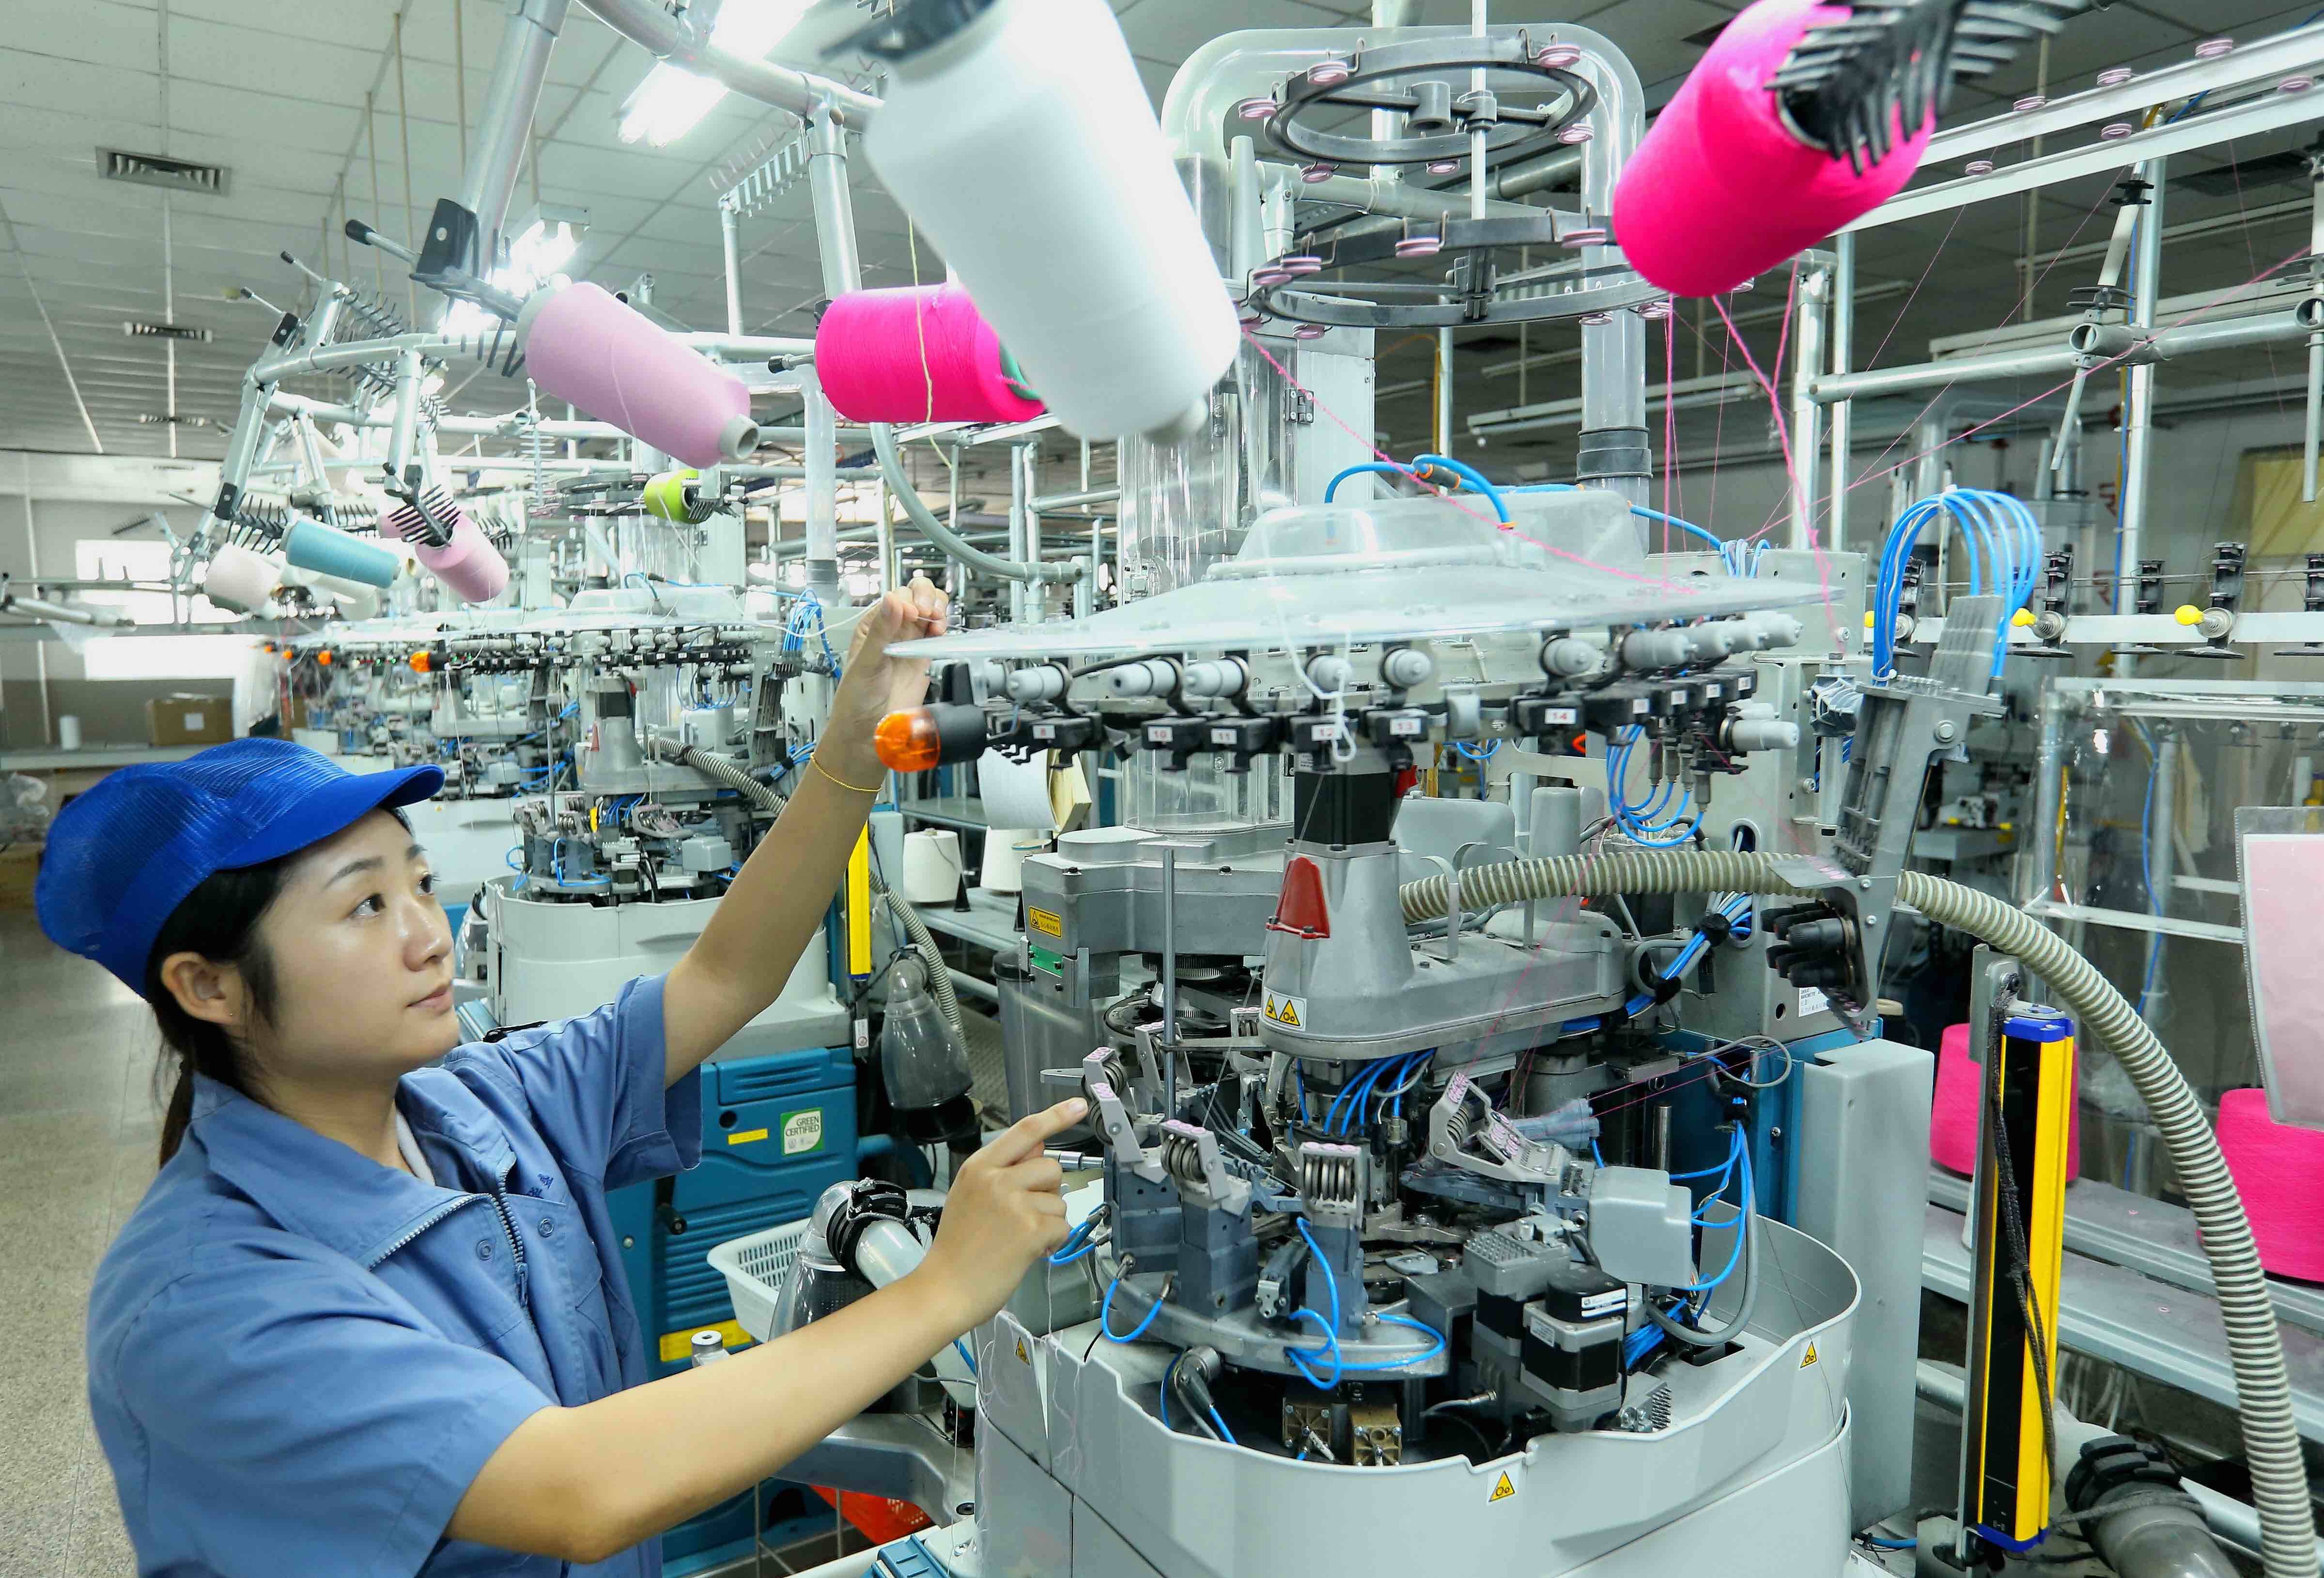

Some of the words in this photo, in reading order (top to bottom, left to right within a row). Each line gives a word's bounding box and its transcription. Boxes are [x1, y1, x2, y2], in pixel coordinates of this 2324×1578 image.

[1552, 712, 1568, 721] 14
[796, 1116, 819, 1126] GREEN
[786, 1124, 820, 1136] CERTIFIED
